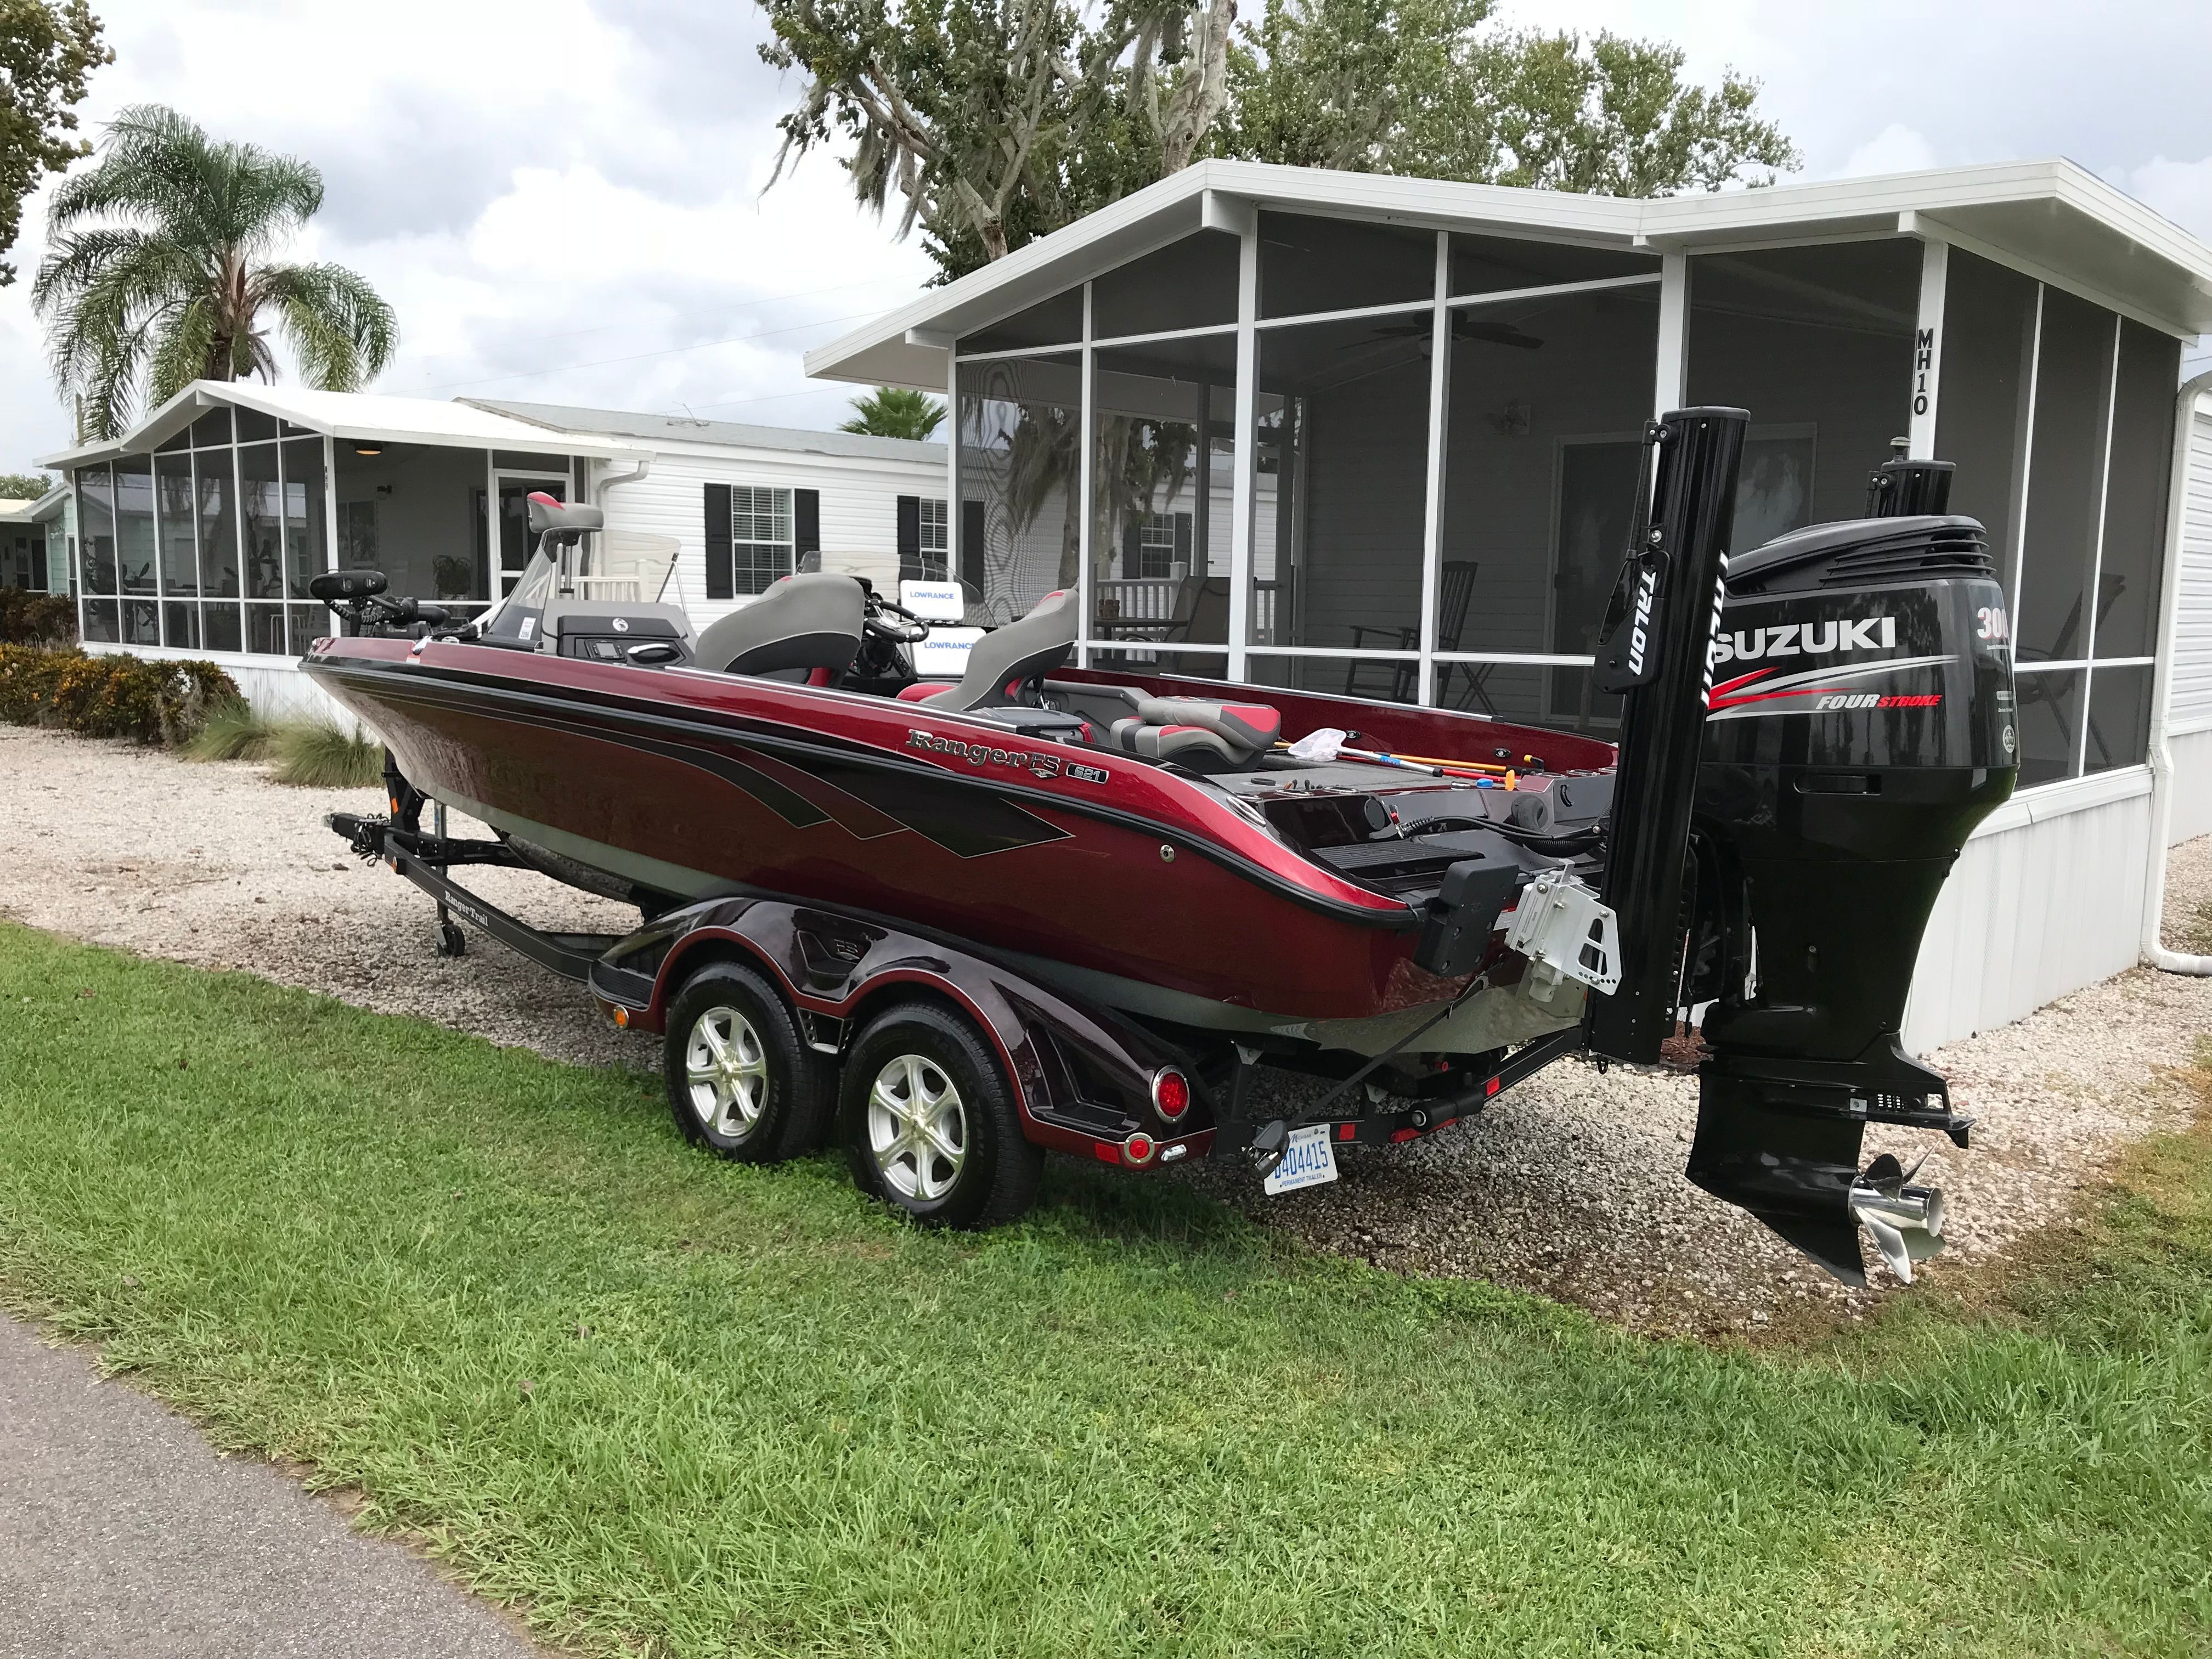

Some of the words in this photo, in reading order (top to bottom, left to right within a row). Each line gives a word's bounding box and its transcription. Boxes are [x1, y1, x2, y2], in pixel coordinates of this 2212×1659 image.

[910, 591, 955, 599] LOWRANCE
[1628, 571, 1657, 675] TALON
[1714, 616, 1896, 664] SUZUKI
[906, 729, 1027, 768] Ranger
[1074, 766, 1101, 782] 621
[1282, 1176, 1306, 1187] PERMANENT
[1306, 1172, 1323, 1181] TRAILER
